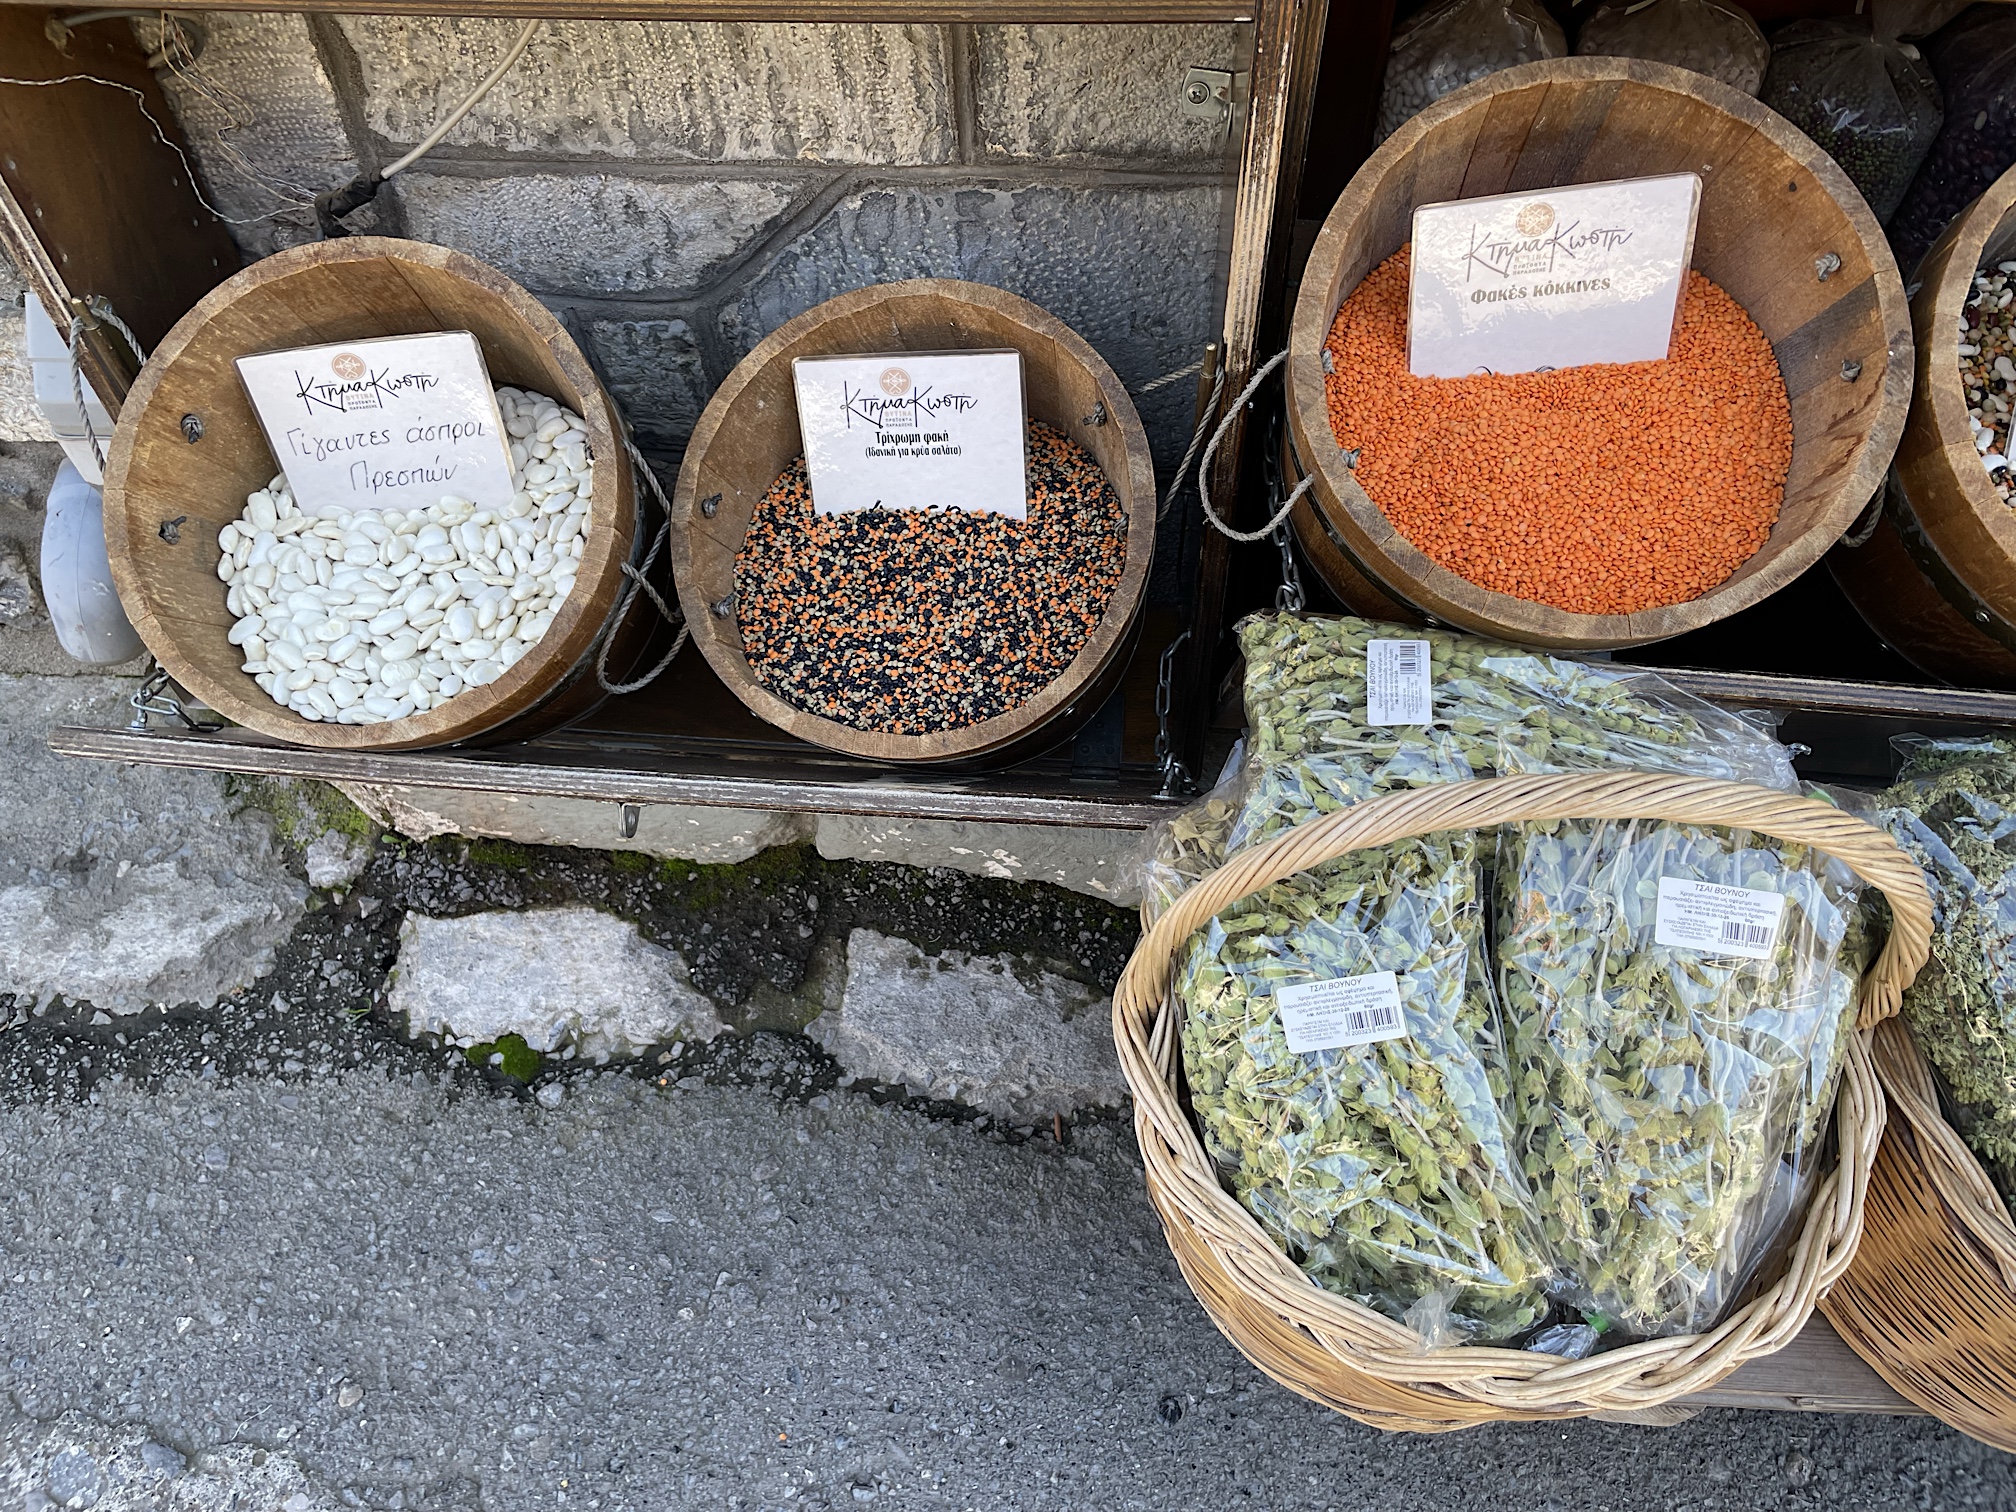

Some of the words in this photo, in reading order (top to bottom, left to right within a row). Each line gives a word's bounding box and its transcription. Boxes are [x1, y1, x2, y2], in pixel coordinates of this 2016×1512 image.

[1470, 284, 1527, 304] Φακές
[1533, 278, 1611, 297] κόκκινες
[286, 428, 390, 461] Γίγαντες
[406, 416, 486, 443] άσπροι
[875, 431, 921, 446] Τρίχρωμη
[923, 430, 949, 445] φακή
[865, 447, 896, 458] (Ιδανική
[898, 447, 909, 458] για
[911, 446, 930, 458] κρύα
[931, 445, 962, 457] σαλάτα)
[350, 455, 457, 494] Πρεσπών
[1694, 883, 1713, 892] ΤΣΑΙ
[1714, 886, 1750, 898] ΒΟΥΝΟΥ
[1308, 983, 1326, 992] ΤΣΑΙ
[1327, 977, 1362, 989] ΒΟΥΝΟΥ
